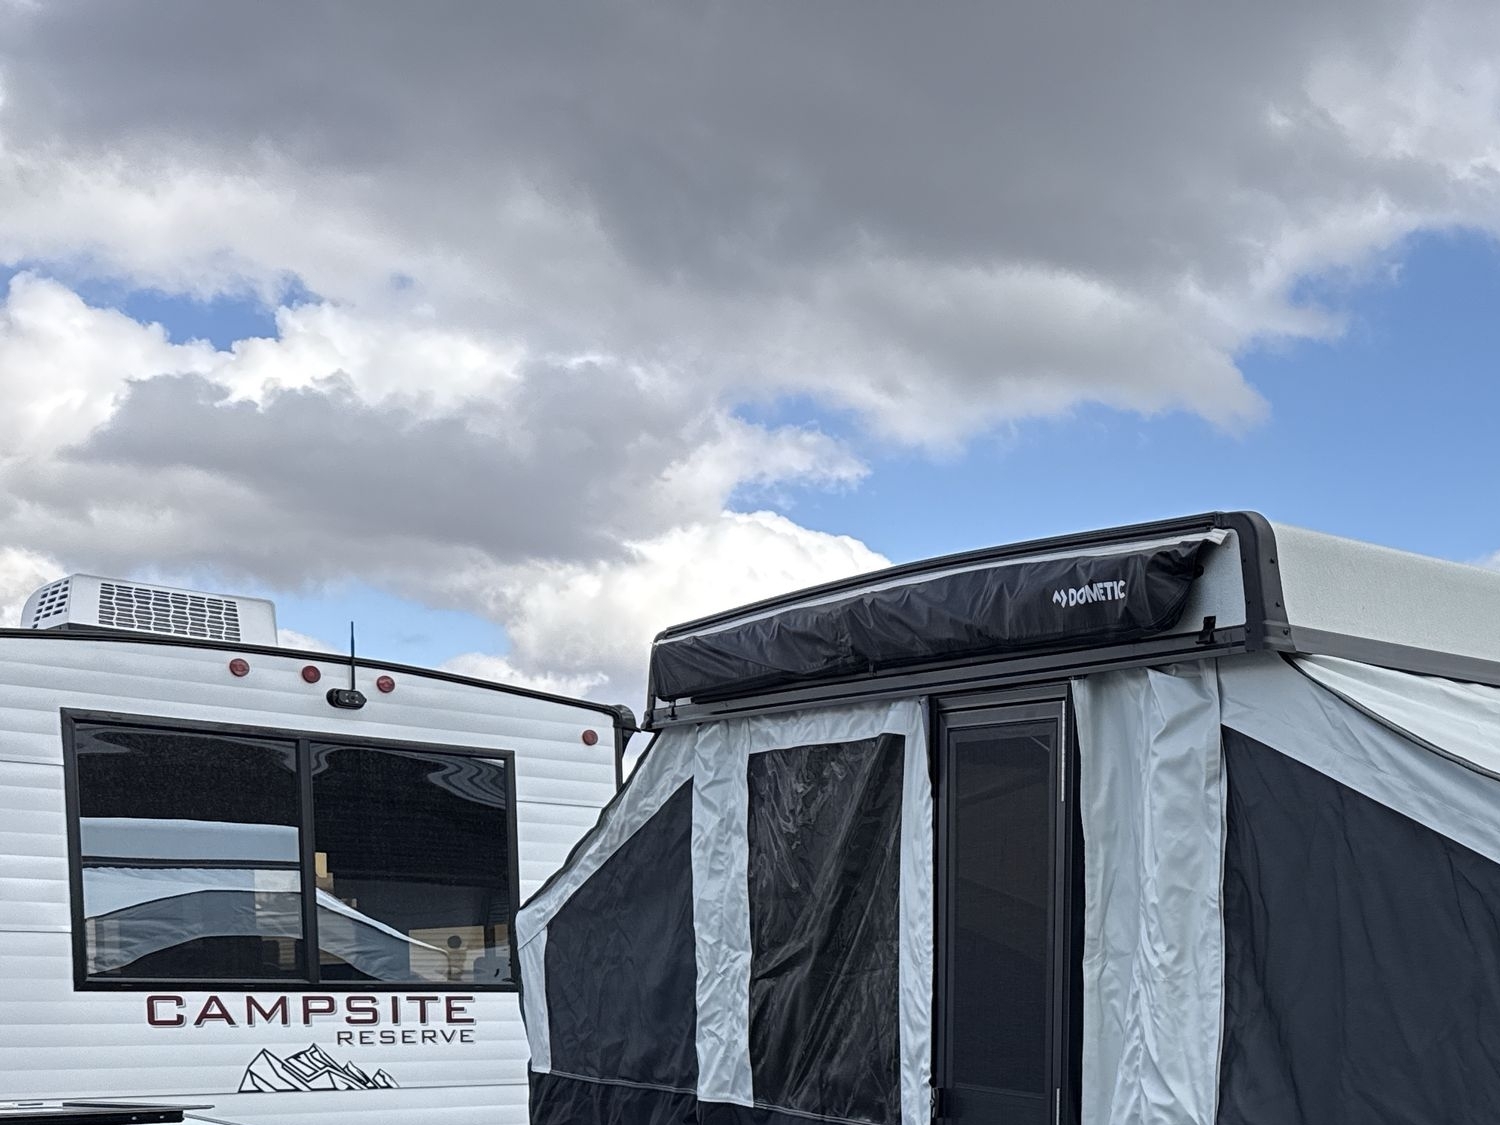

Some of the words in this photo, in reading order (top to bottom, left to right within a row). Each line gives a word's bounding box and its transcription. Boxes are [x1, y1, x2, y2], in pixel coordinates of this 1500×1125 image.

[1068, 580, 1126, 607] DOMETIC
[146, 994, 476, 1028] CAMPSITE
[336, 1029, 476, 1046] RESERVE
